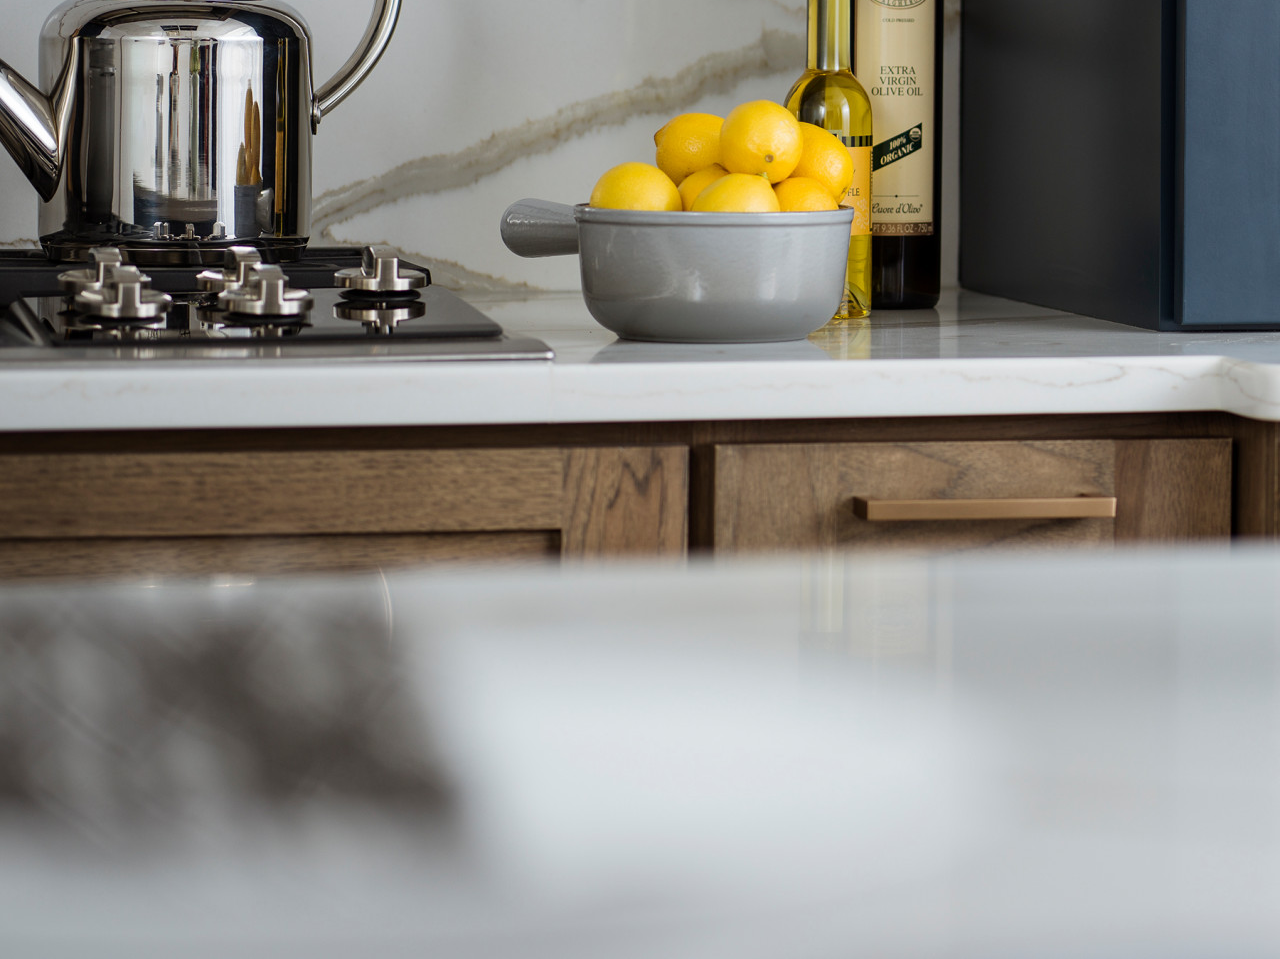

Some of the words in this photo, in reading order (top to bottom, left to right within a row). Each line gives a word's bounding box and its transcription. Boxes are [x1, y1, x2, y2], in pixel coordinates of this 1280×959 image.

[880, 65, 916, 75] EXTRA
[880, 76, 917, 86] VIRGIN
[871, 86, 904, 96] OLIVE
[906, 86, 924, 96] OIL
[889, 136, 907, 150] 100%
[880, 142, 915, 165] ORGANIC
[904, 223, 914, 233] OZ
